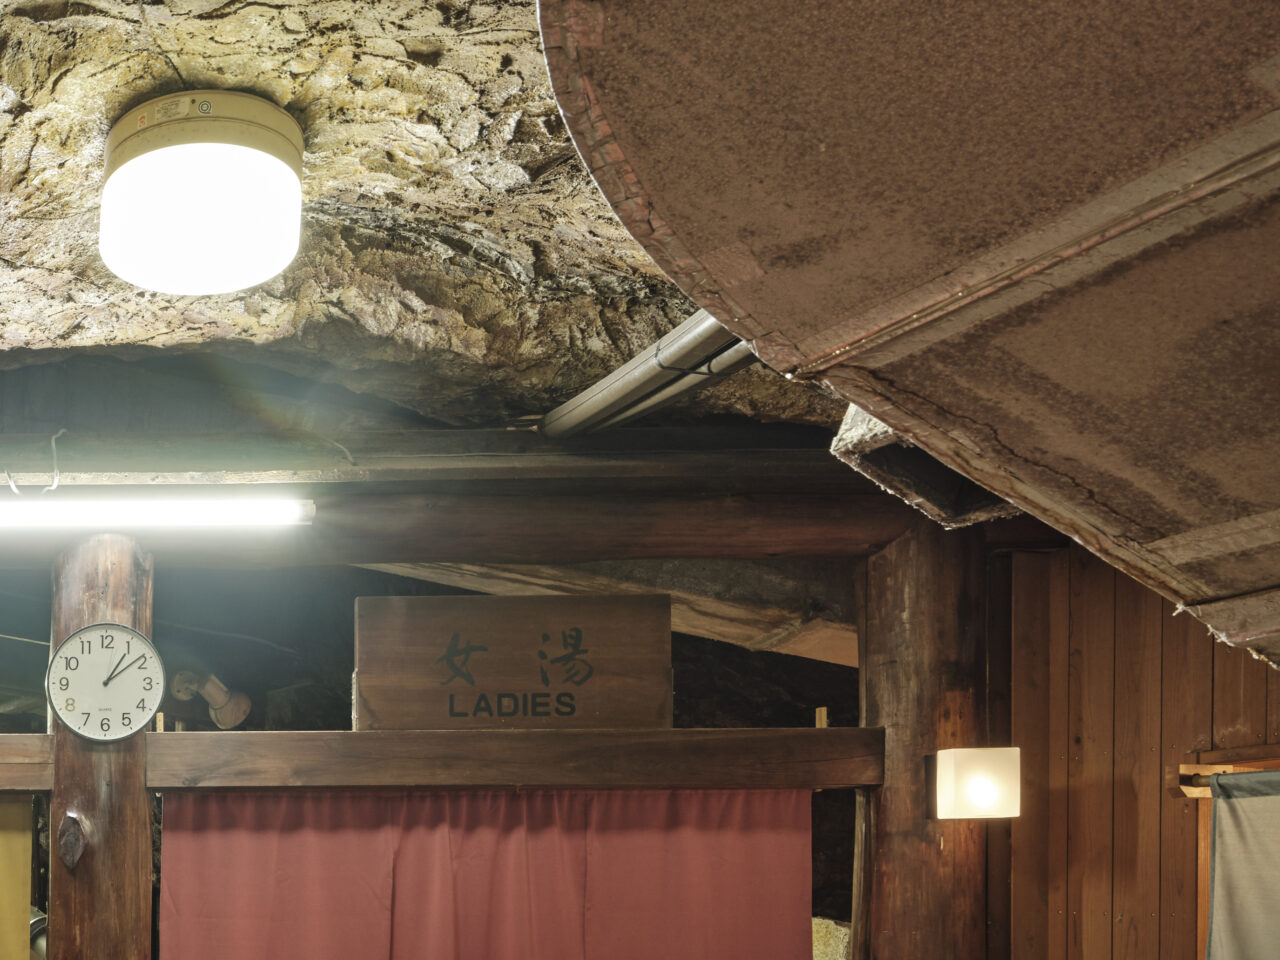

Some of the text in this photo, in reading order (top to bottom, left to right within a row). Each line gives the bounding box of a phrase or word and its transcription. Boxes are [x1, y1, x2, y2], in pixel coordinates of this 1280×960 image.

[80, 640, 92, 655] 11
[100, 634, 114, 649] 12
[125, 640, 130, 655] 1
[64, 656, 79, 671] 10
[137, 654, 148, 670] 2
[435, 627, 594, 687] 女湯
[59, 677, 69, 691] 9
[143, 677, 152, 691] 3
[65, 698, 75, 712] 8
[136, 698, 146, 712] 4
[449, 692, 577, 718] LADIES
[81, 712, 91, 726] 7
[100, 717, 110, 731] 6
[122, 712, 131, 726] 5
